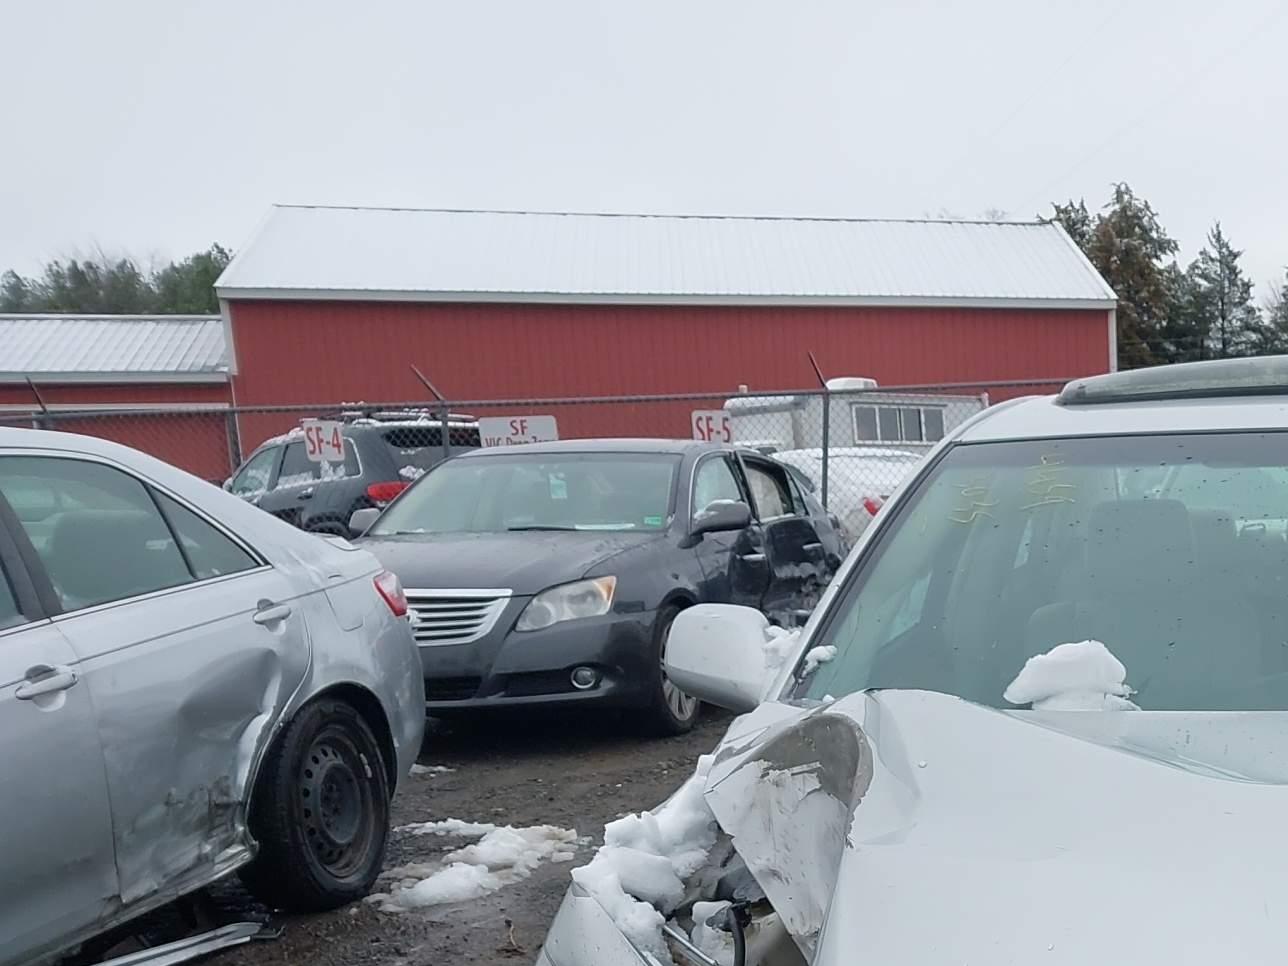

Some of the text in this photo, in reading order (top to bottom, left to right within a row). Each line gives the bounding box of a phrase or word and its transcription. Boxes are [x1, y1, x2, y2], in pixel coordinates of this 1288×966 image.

[306, 426, 341, 455] SF-4
[510, 420, 528, 435] SF
[696, 416, 731, 443] SF-5
